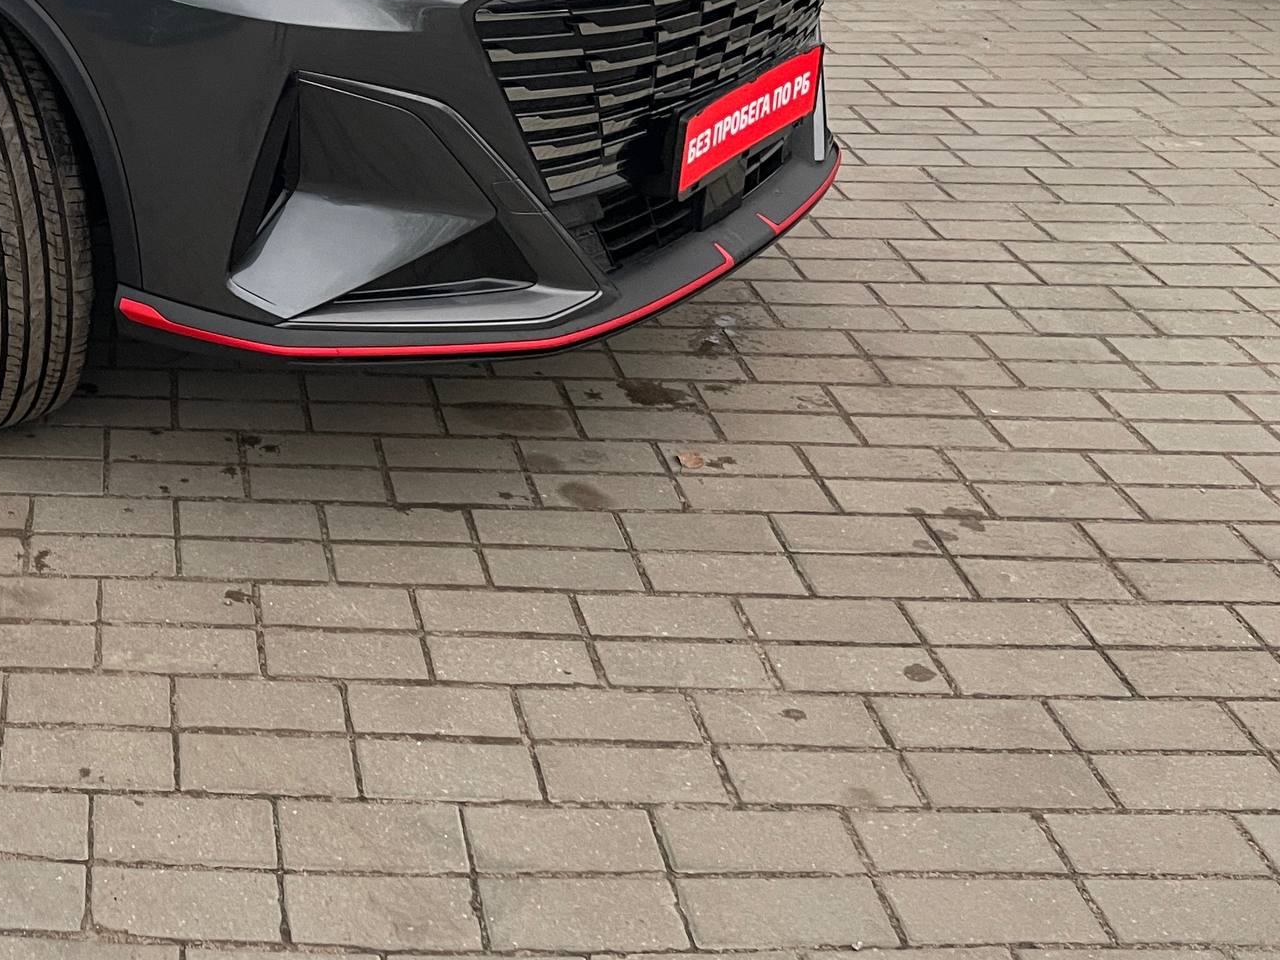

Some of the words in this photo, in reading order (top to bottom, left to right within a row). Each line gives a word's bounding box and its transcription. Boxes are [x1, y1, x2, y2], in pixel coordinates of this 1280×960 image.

[687, 128, 712, 164] БЕЗ
[712, 93, 771, 147] ПРОБЕГА
[772, 81, 792, 112] ПО
[793, 71, 811, 100] РБ
